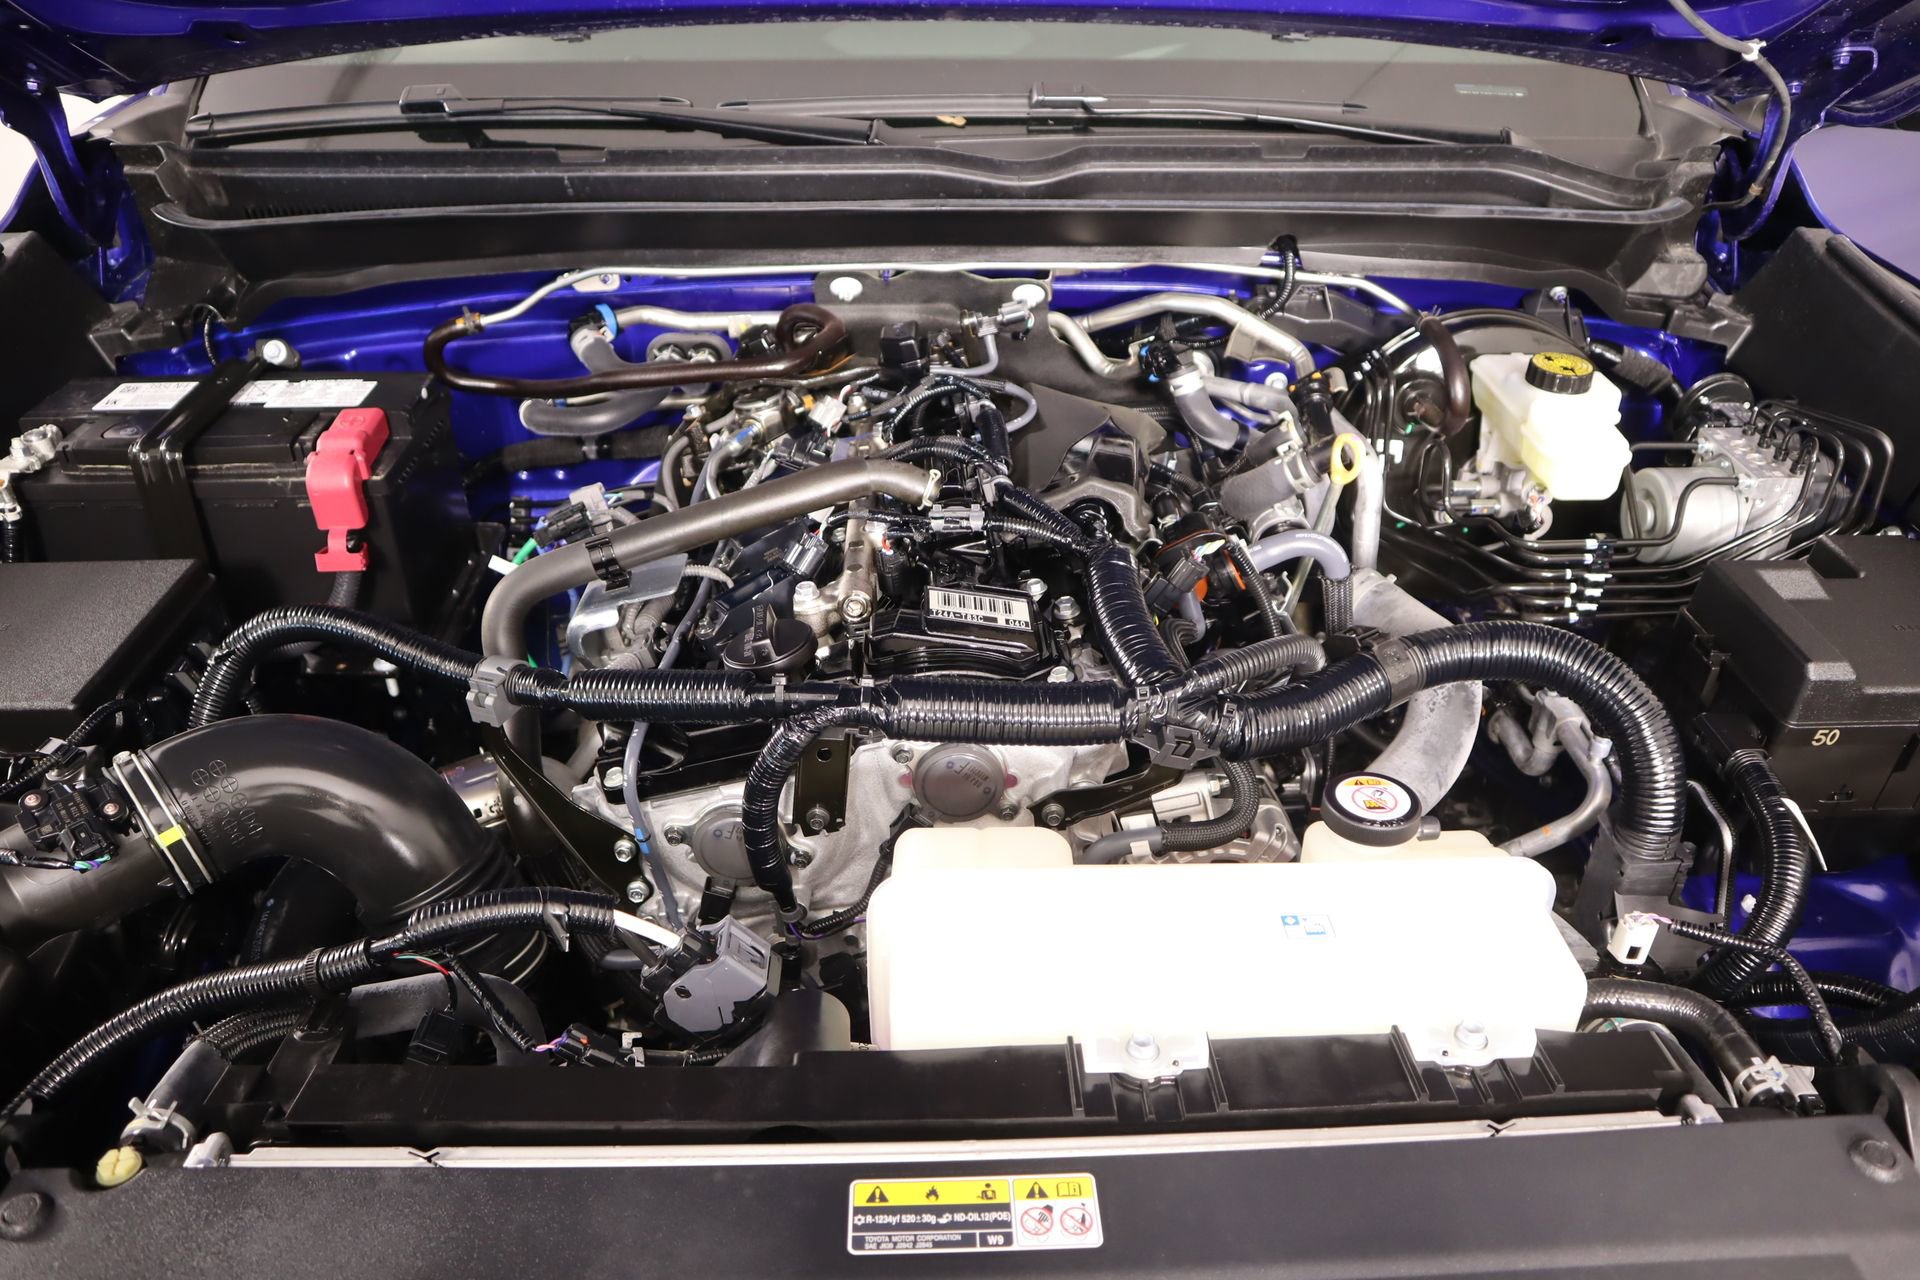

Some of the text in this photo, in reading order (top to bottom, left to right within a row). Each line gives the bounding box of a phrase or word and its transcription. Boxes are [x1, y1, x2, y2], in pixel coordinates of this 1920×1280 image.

[1811, 729, 1840, 746] 50
[866, 1214, 900, 1225] R-1234yf
[953, 1211, 1011, 1223] ND-OIL12(POE)
[864, 1235, 889, 1243] TOYOTA
[916, 1233, 962, 1241] CORPORATION
[986, 1234, 1004, 1245] W9
